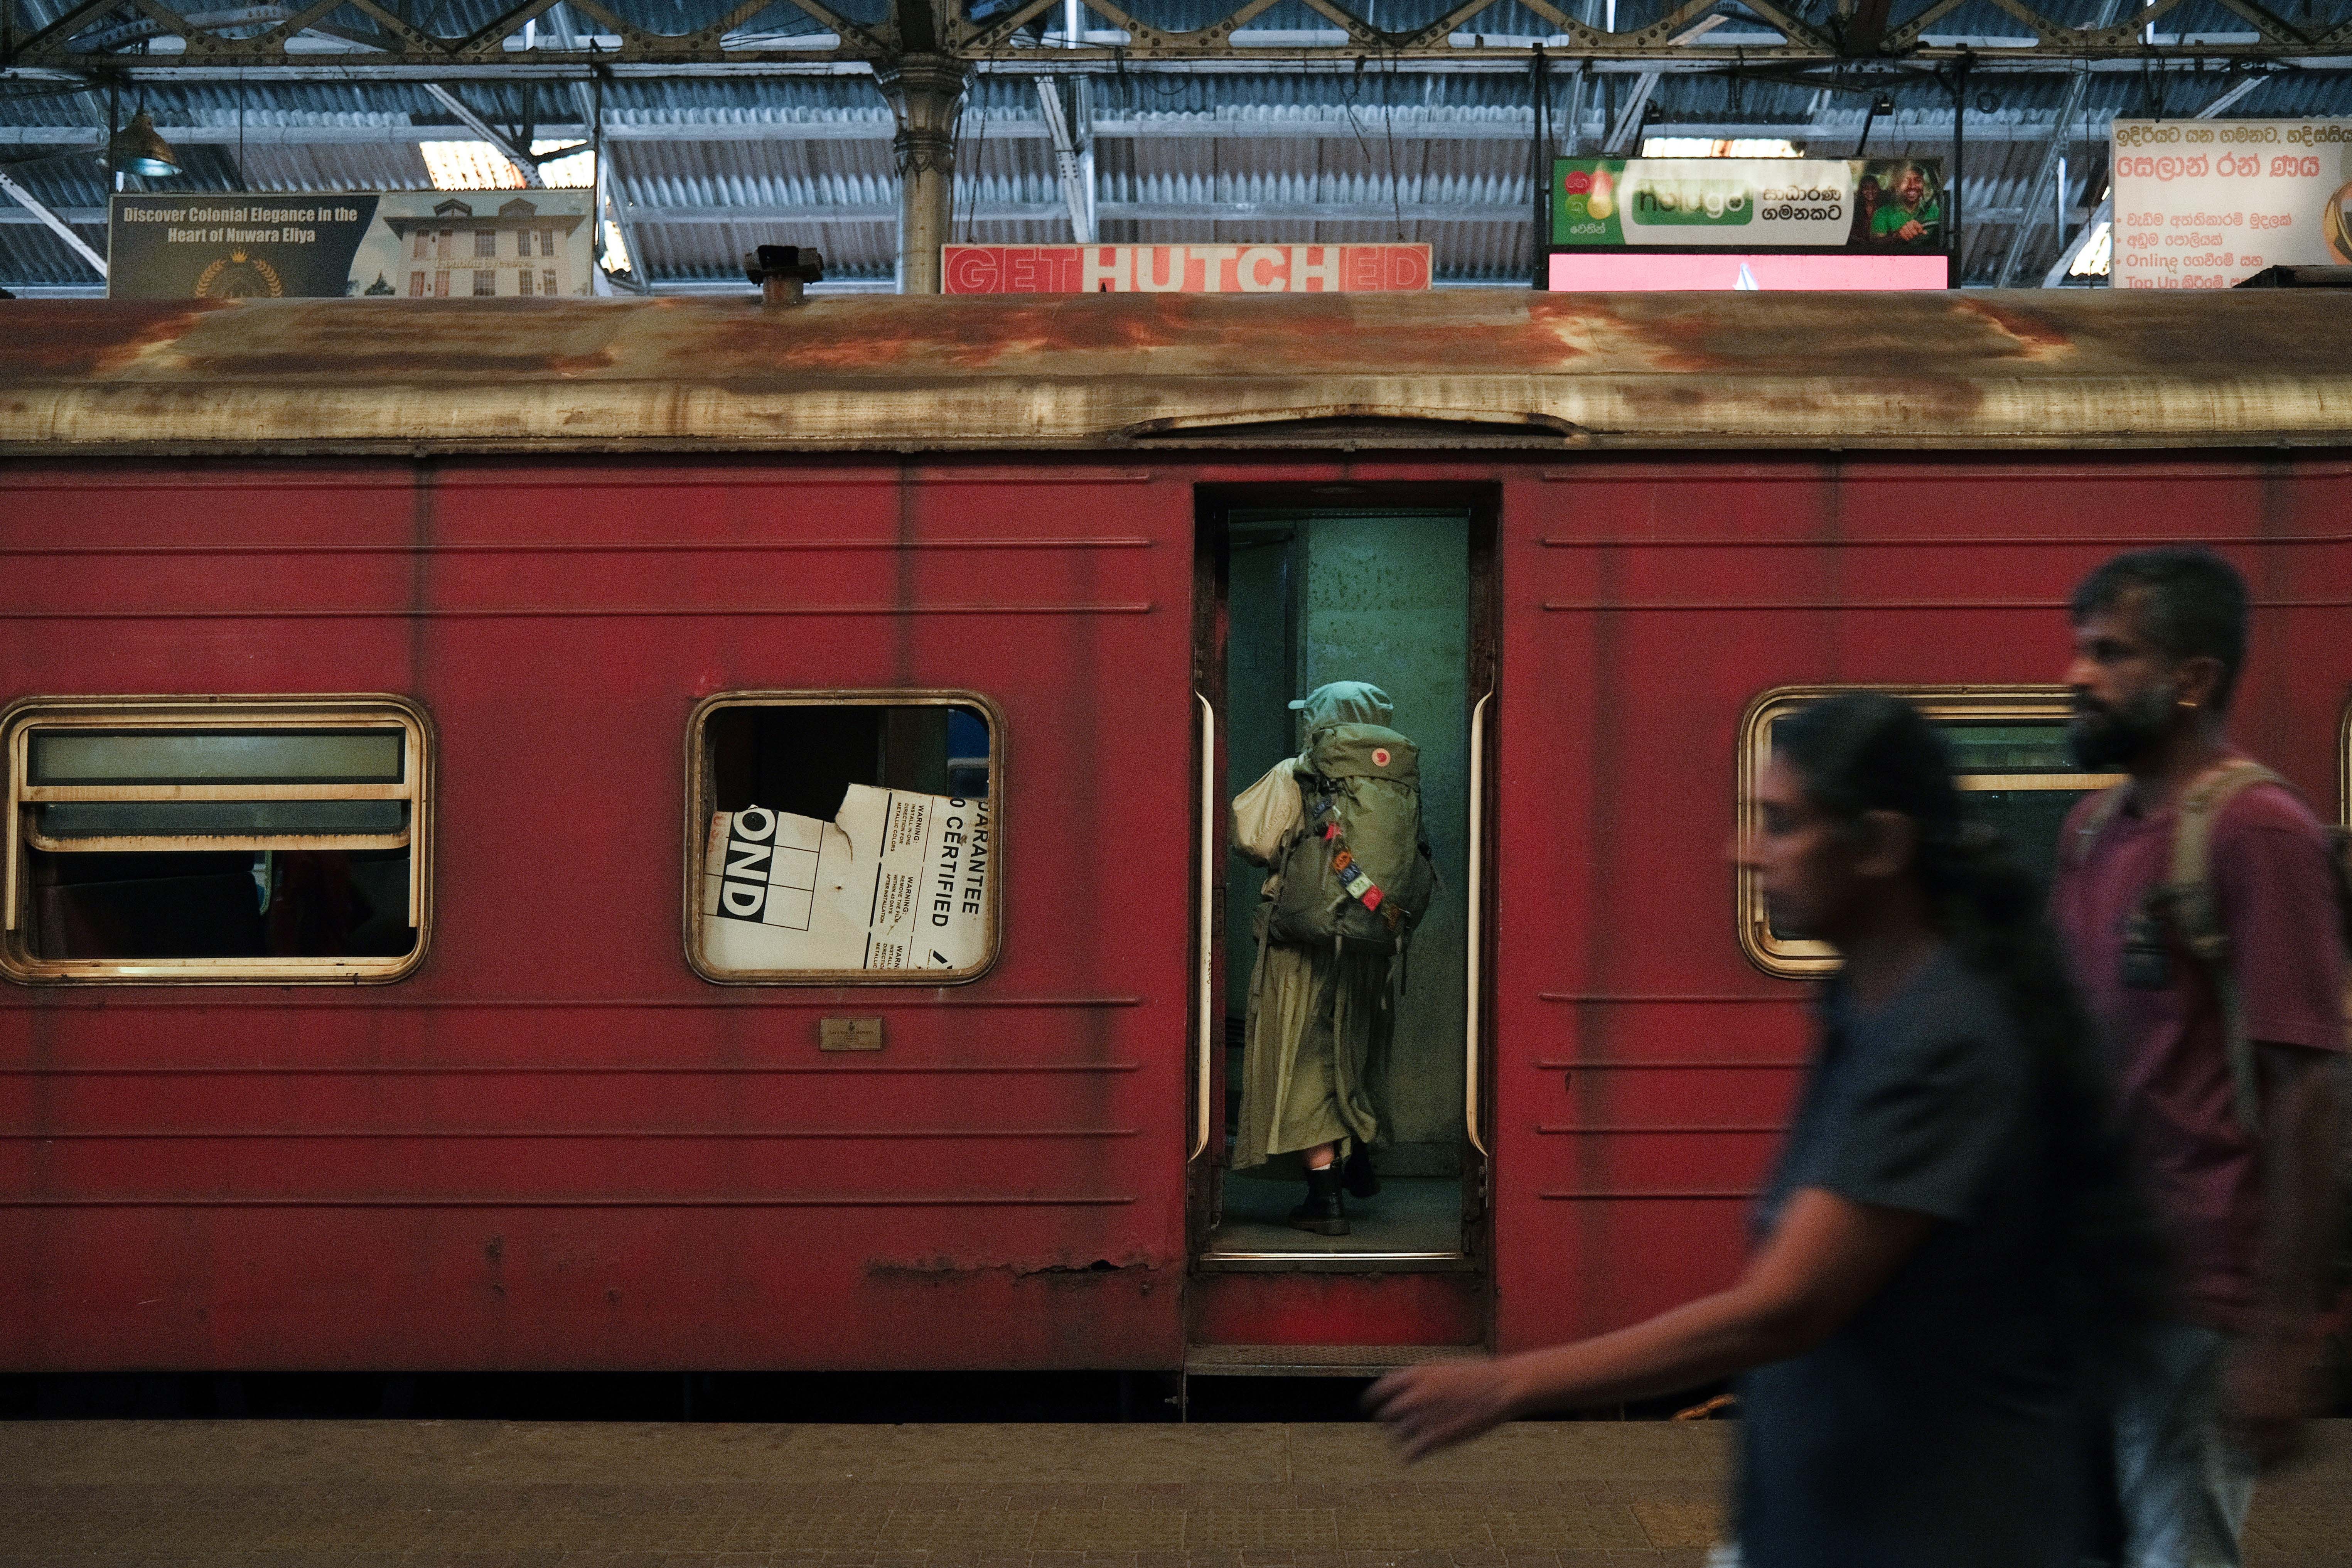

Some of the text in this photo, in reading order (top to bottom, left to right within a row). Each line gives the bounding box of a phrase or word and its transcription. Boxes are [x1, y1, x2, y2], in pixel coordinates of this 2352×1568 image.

[2186, 128, 2214, 143] යන
[2216, 151, 2261, 177] රන්
[2269, 155, 2321, 177] ණය
[123, 207, 357, 224] Discover Colonial Elegance in the
[1762, 204, 1842, 221] ගමනකට
[168, 228, 315, 244] Heart of Nuwara Eliya
[2126, 254, 2178, 267] Online
[2126, 276, 2154, 288] Top
[2158, 276, 2179, 288] Up
[890, 802, 902, 852] METALLIC COLORS
[900, 803, 909, 831] DIRECTION
[913, 805, 924, 843] WARNING:
[932, 816, 963, 927] CERTIFIED
[897, 875, 905, 897] REMOVE
[902, 877, 914, 915] WARNING:
[880, 890, 888, 924] INSTALLATION
[872, 942, 881, 969] METALLIC
[880, 943, 888, 969] DIRECTIO
[894, 946, 903, 969] WARN
